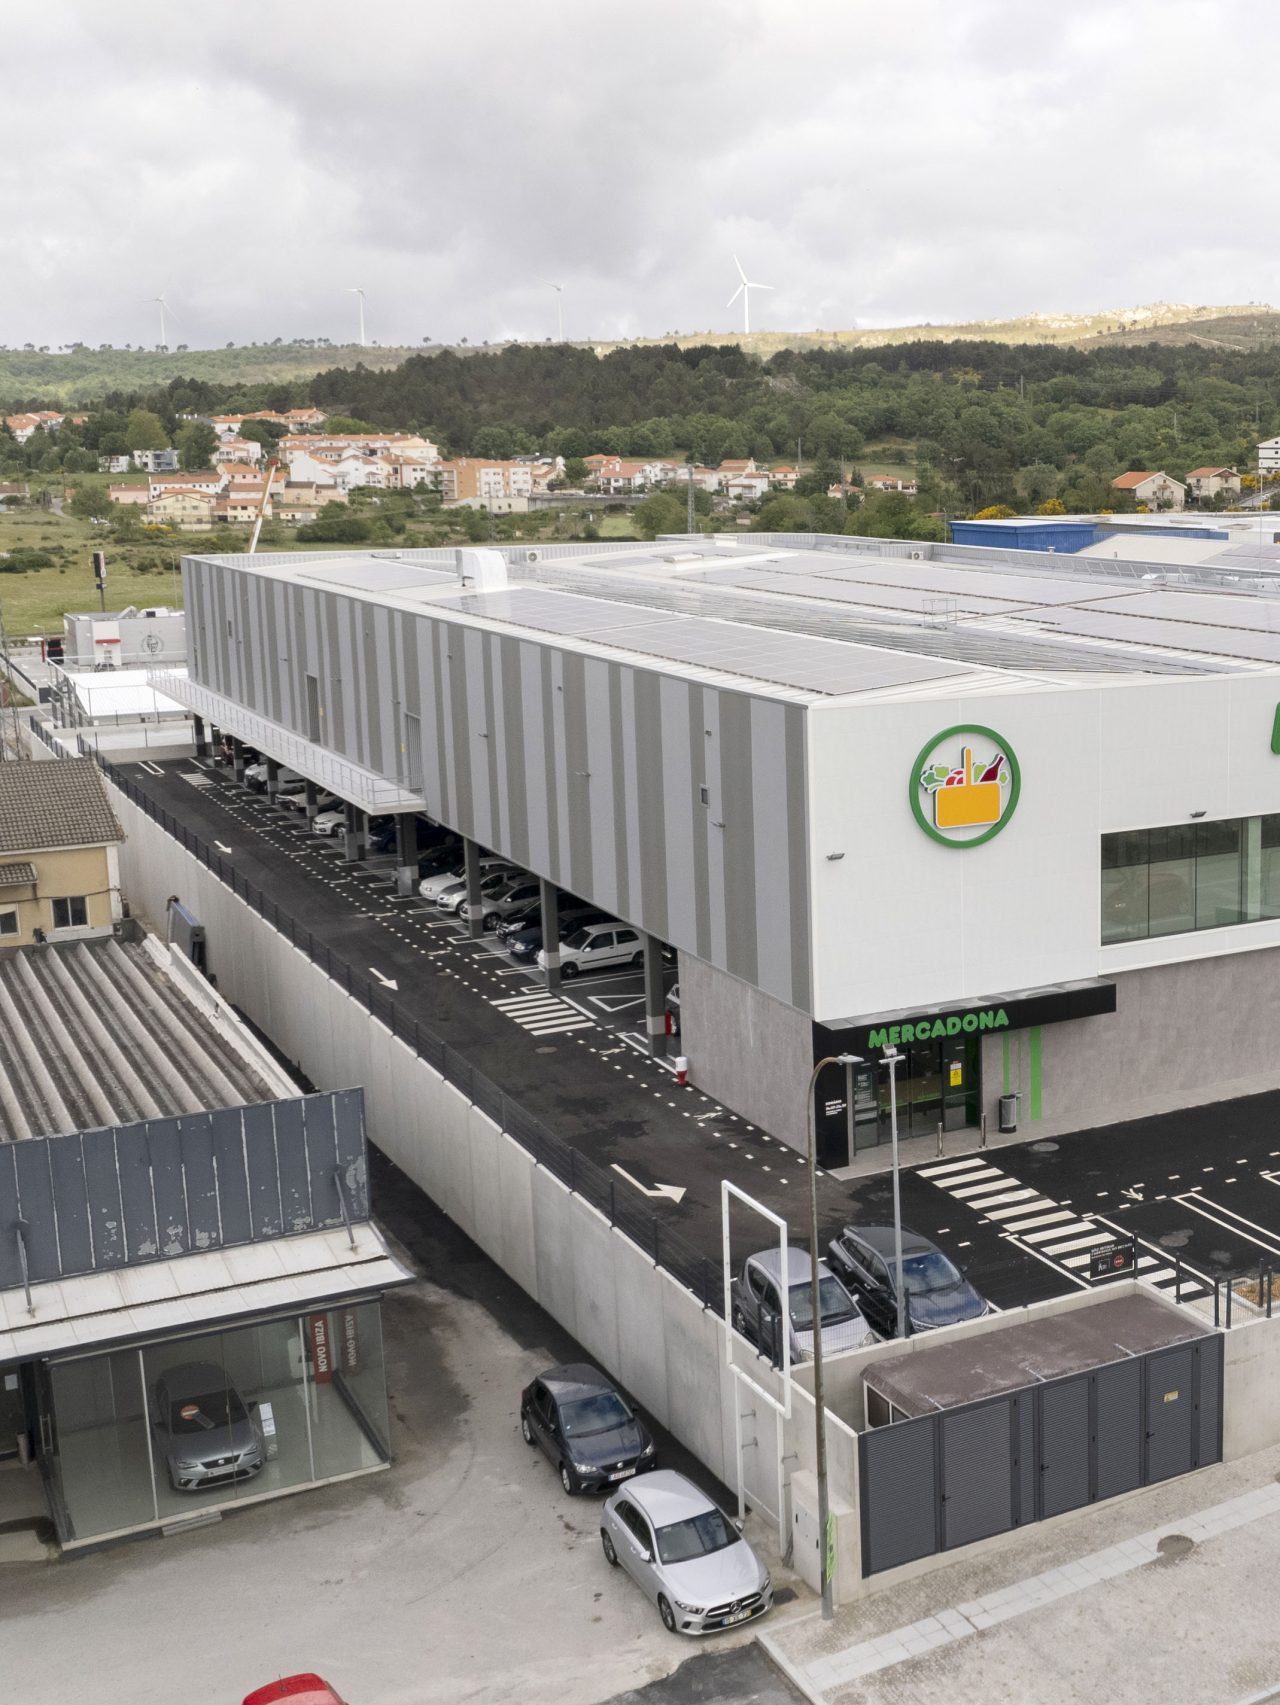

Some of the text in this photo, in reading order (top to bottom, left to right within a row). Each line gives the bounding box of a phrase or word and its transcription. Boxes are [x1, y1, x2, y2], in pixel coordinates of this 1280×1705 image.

[868, 1008, 1010, 1049] MERCADONA
[314, 1320, 328, 1373] NOVO IBIZA
